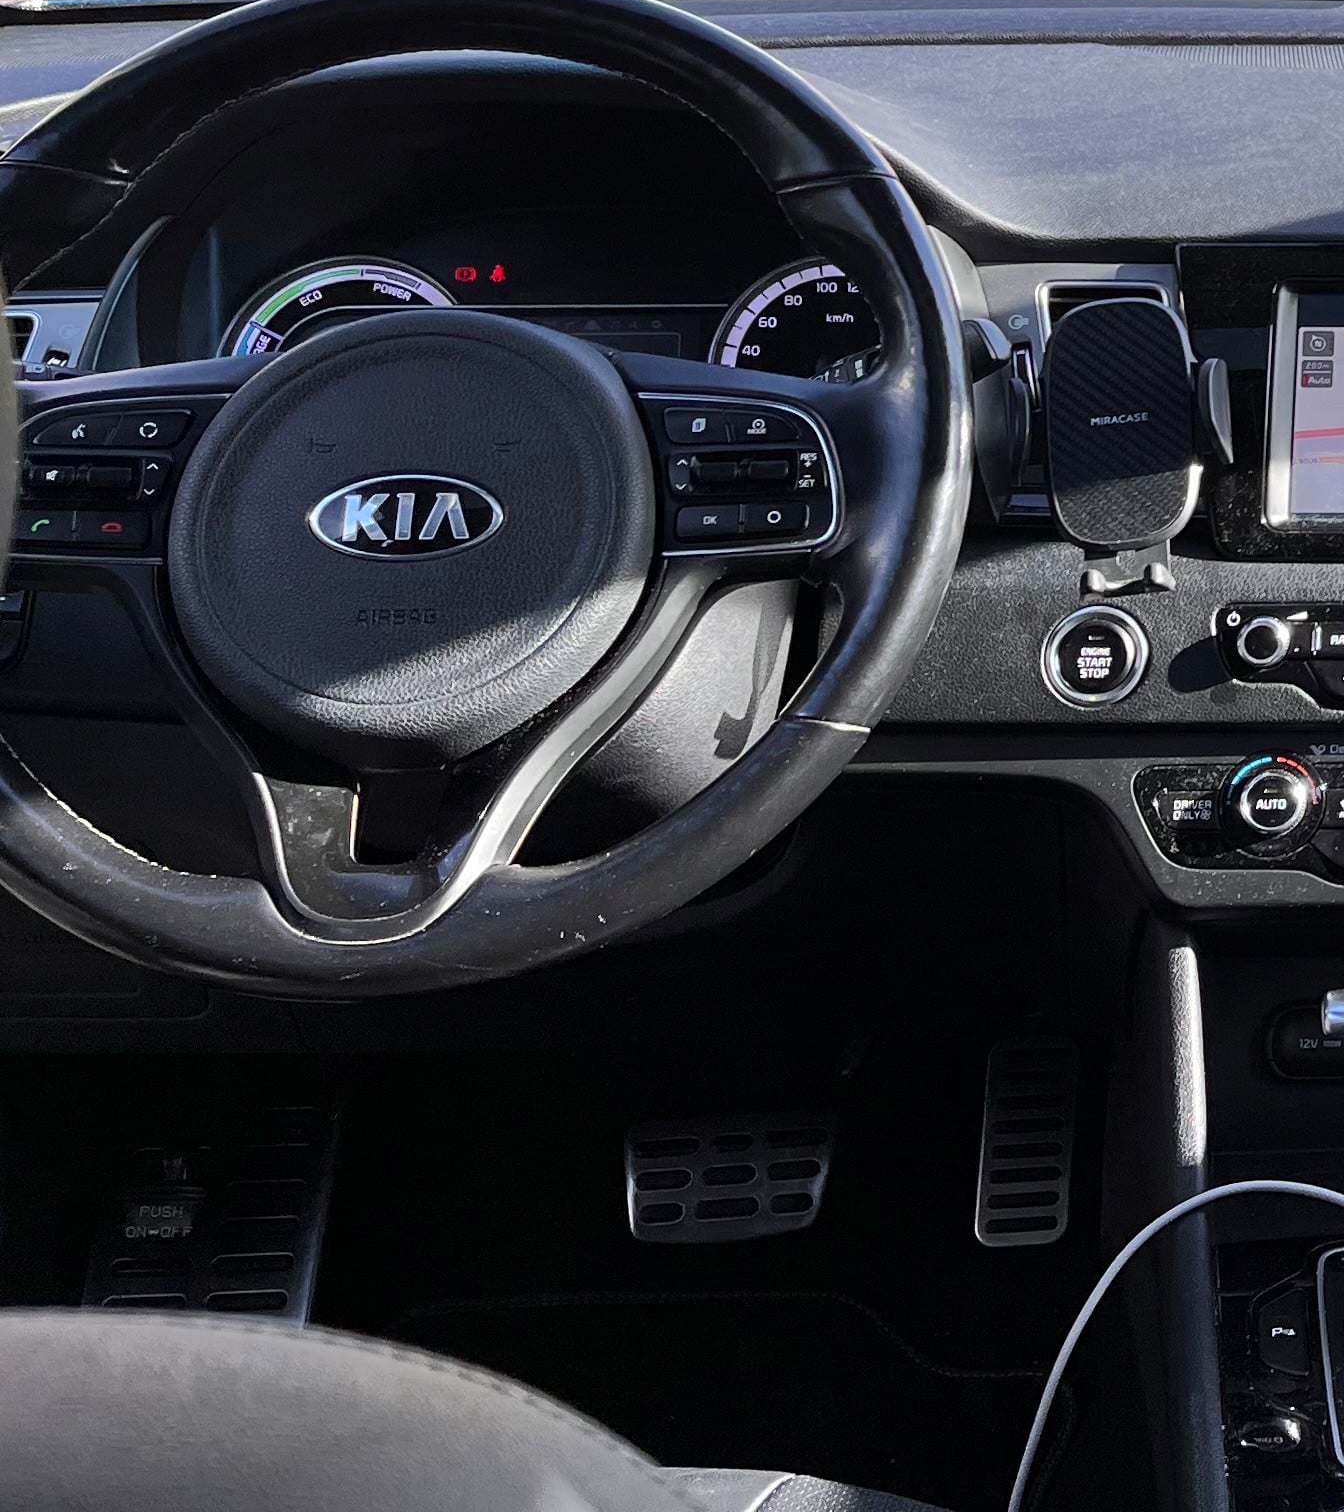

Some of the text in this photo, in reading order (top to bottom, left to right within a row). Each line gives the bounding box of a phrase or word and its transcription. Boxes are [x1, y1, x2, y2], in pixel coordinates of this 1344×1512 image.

[372, 282, 412, 302] POWER
[816, 282, 838, 293] 100
[299, 289, 323, 307] ECO
[784, 295, 803, 306] 80
[758, 316, 778, 328] 60
[825, 313, 854, 323] km/h
[742, 345, 761, 356] 40
[1308, 376, 1331, 385] Auto
[1090, 412, 1149, 426] MIRACASE
[800, 452, 818, 461] RES
[798, 479, 816, 488] SET
[341, 493, 470, 541] KIA
[703, 515, 718, 525] OK
[357, 608, 438, 626] AIRBAG
[1076, 657, 1113, 667] START
[1079, 668, 1109, 678] STOP
[1173, 799, 1212, 810] DRIVER
[1256, 799, 1287, 810] AUTO
[1172, 810, 1201, 820] ONLY
[1299, 1039, 1319, 1049] 12V
[138, 1205, 184, 1219] PUSH
